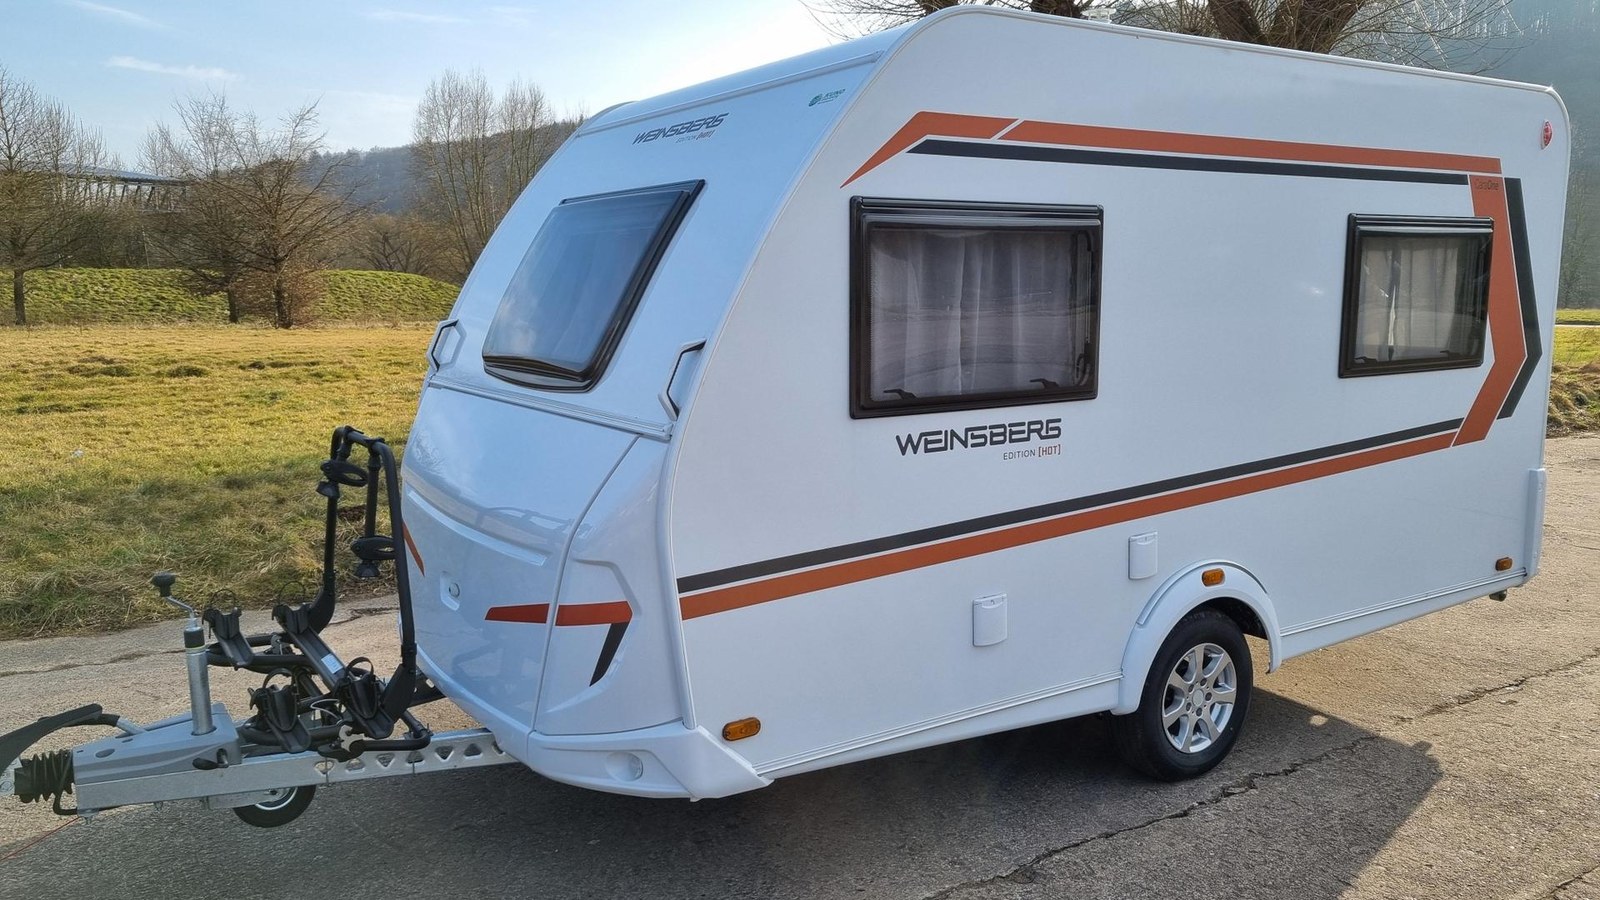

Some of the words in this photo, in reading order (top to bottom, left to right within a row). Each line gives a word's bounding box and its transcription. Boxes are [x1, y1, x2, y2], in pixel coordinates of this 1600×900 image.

[632, 112, 730, 145] WEINSBERG
[895, 417, 1062, 456] WEINSBERG
[1003, 449, 1036, 461] EDITION
